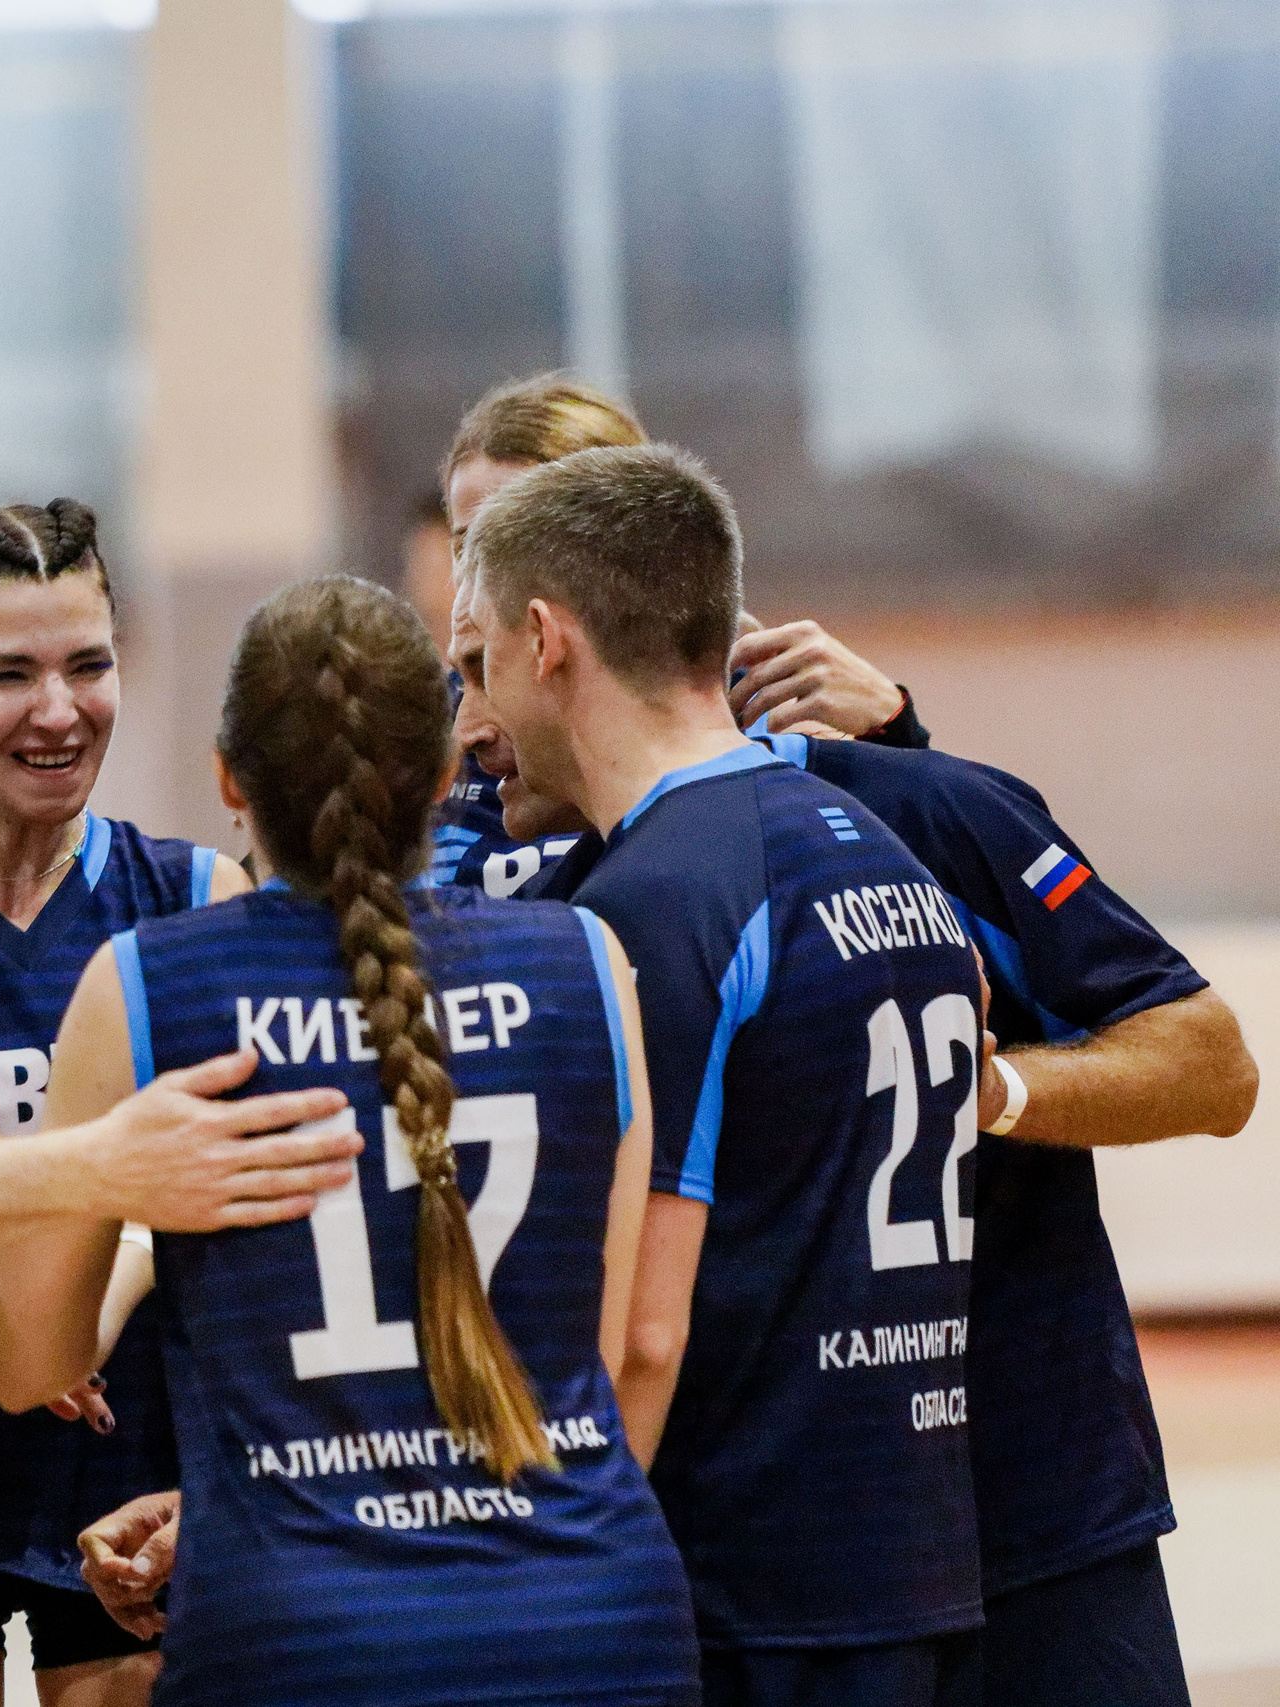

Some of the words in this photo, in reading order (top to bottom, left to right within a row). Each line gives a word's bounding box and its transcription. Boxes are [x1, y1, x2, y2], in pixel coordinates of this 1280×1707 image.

[236, 981, 531, 1064] КИЕР
[866, 993, 978, 1271] 22
[289, 1093, 539, 1381] 17
[354, 1486, 535, 1530] ОБЛАСТЬ
